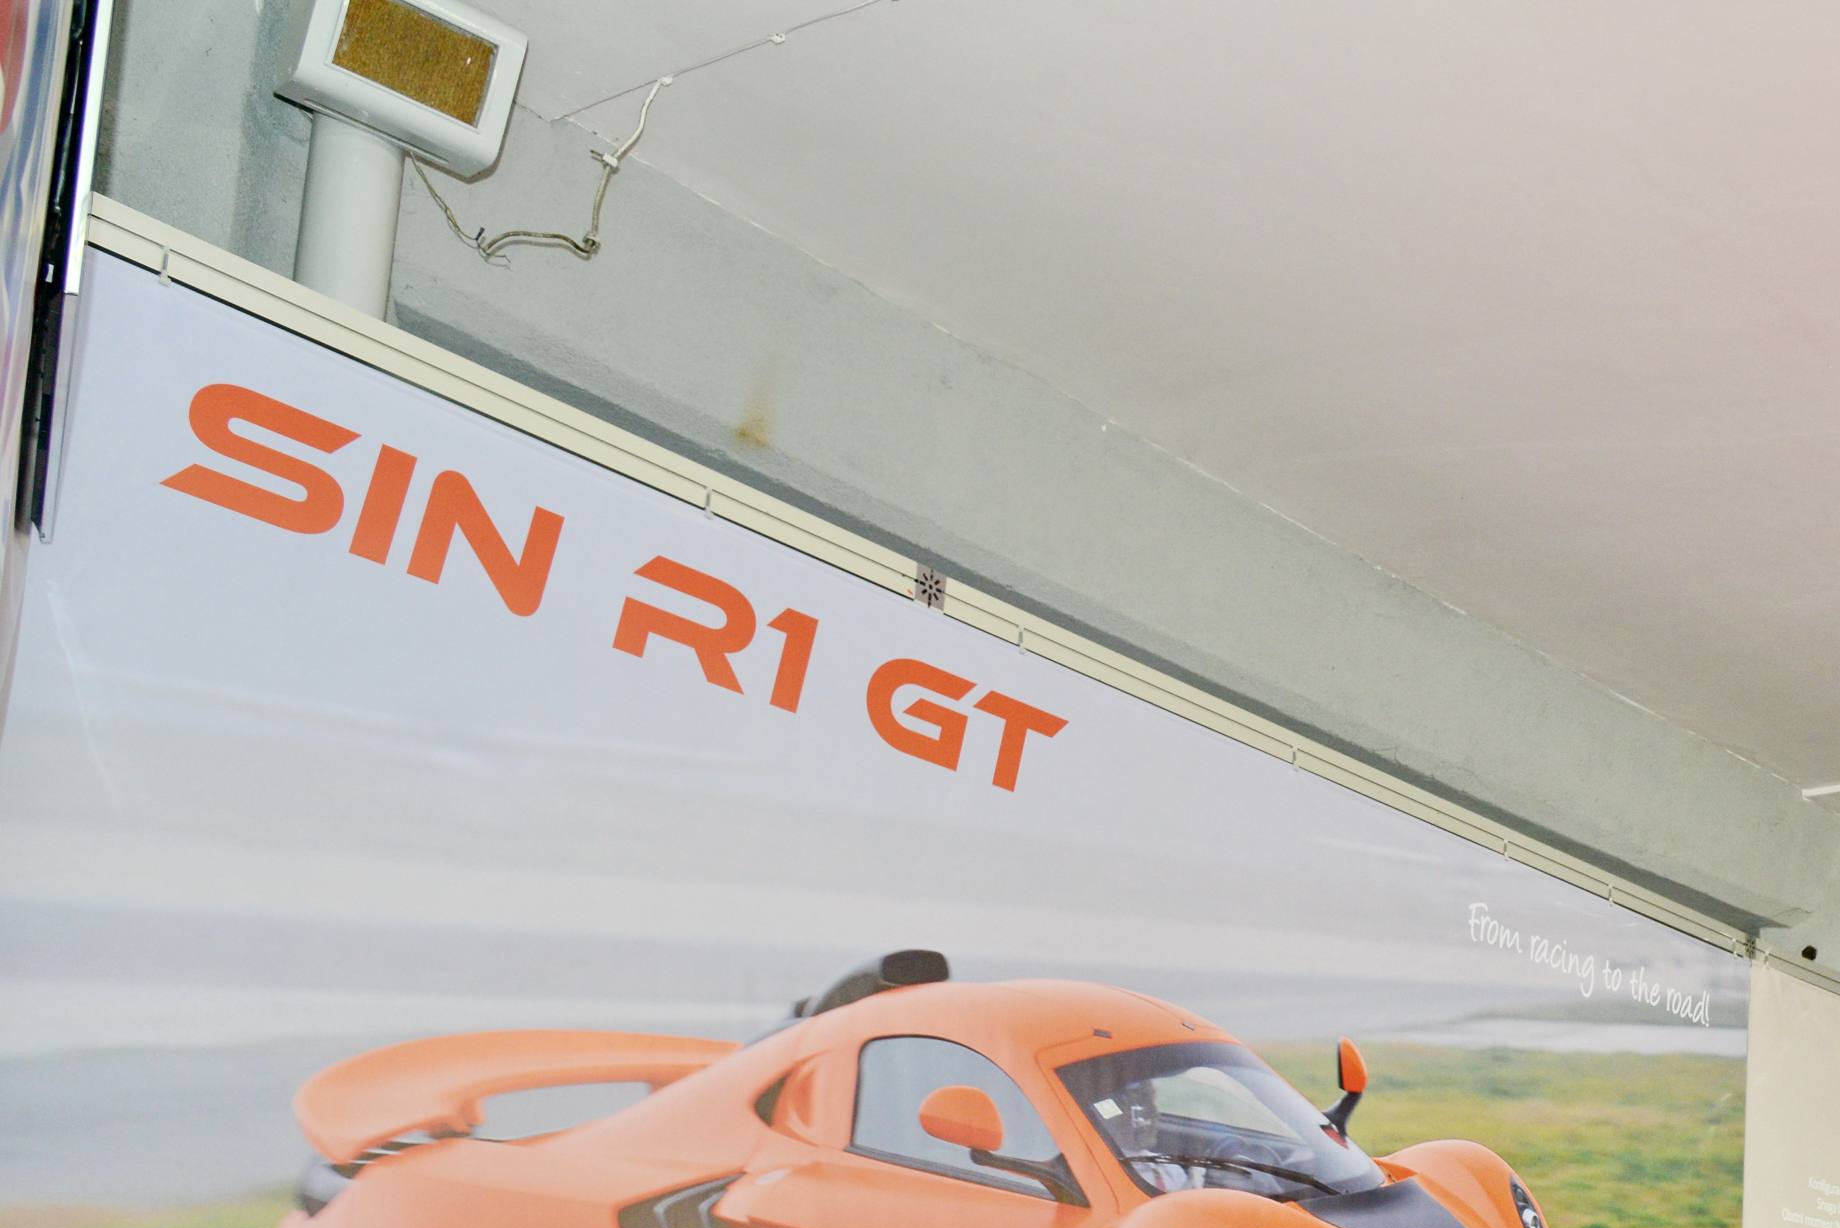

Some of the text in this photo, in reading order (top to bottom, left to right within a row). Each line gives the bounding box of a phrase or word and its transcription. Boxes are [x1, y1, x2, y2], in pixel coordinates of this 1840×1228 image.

[159, 383, 1069, 793] SIN R1 GT
[1468, 902, 1710, 1027] From racing to the road!
